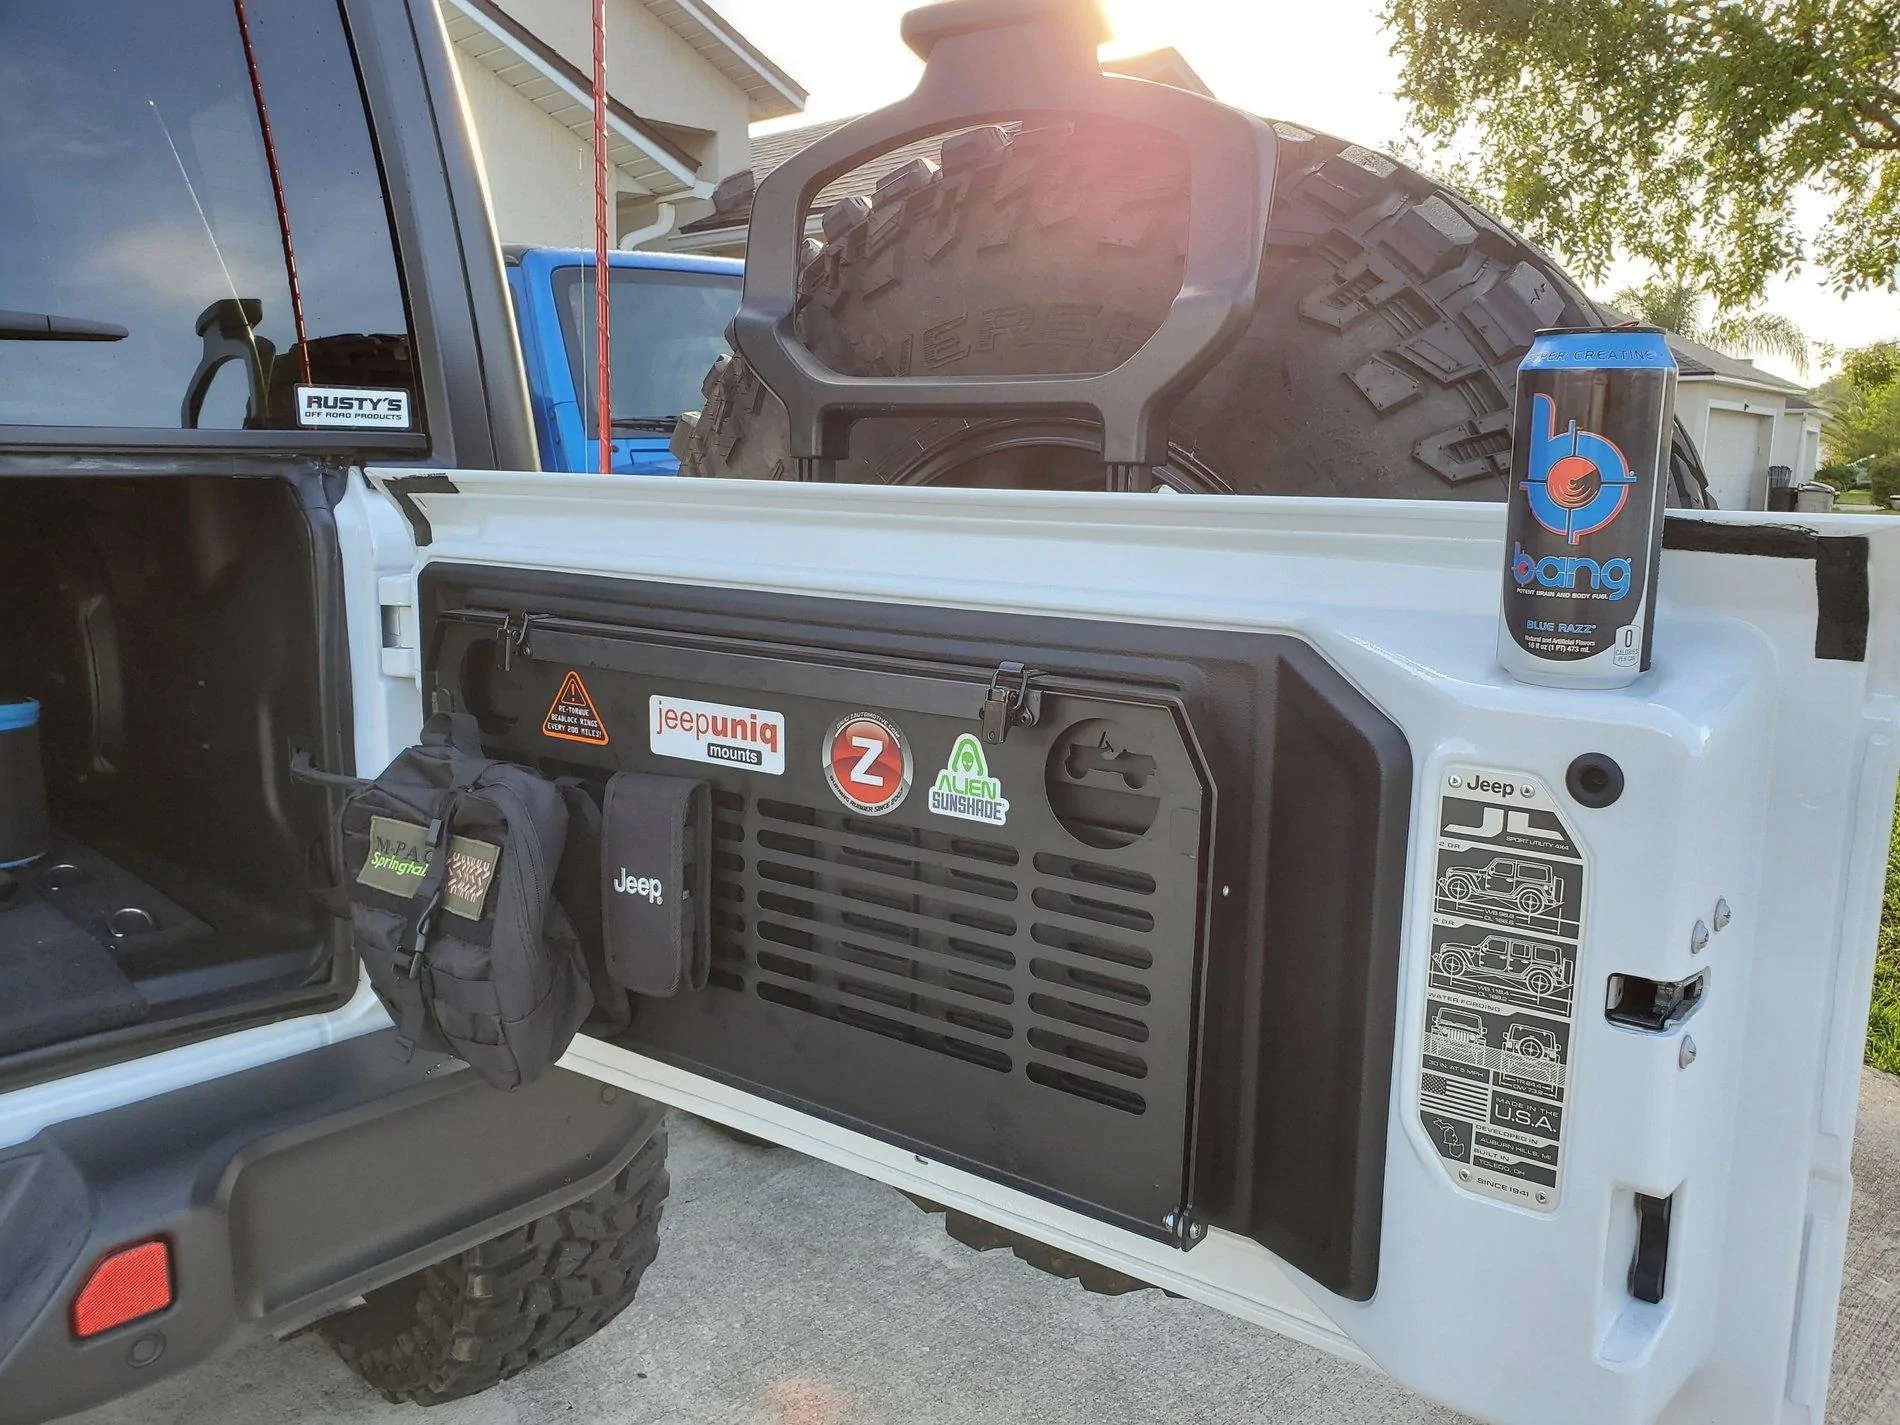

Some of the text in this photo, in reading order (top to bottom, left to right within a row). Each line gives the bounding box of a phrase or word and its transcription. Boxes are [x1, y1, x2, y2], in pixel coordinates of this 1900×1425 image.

[1573, 349, 1655, 361] CREATINE
[307, 395, 402, 411] RUSTY'S
[325, 411, 352, 419] ROAD
[354, 412, 402, 421] PRODUCTS
[1511, 541, 1631, 601] bang
[1536, 589, 1555, 597] BRAIN
[1526, 619, 1555, 632] BLUE
[1528, 641, 1535, 649] 16
[1566, 645, 1580, 653] 473
[1541, 636, 1552, 644] and
[1552, 637, 1575, 645] Artificial
[1624, 629, 1633, 648] 0
[558, 704, 590, 717] RE-TORQUE
[547, 722, 566, 732] EVERY
[567, 725, 579, 734] 200
[551, 713, 598, 728] BEADLOCK RINGS
[656, 700, 778, 754] jeepuniq
[709, 744, 759, 764] mounts
[850, 735, 885, 788] Z
[938, 774, 997, 801] ALIEN
[1467, 775, 1515, 797] Jeep
[932, 790, 1002, 821] SUNSHADE
[1443, 806, 1565, 841] JL
[613, 866, 662, 903] Jeep
[1441, 918, 1455, 926] DR
[1427, 991, 1501, 1013] WATER FORDING
[1449, 1064, 1460, 1072] AT
[1466, 1068, 1484, 1078] MPH
[1495, 1097, 1524, 1109] MADE
[1539, 1107, 1560, 1118] THE
[1494, 1103, 1557, 1133] U.S.A.
[1475, 1124, 1527, 1142] DEVELOPED
[1473, 1147, 1498, 1158] BUILT
[1479, 1137, 1515, 1151] AUBURN
[1513, 1168, 1526, 1176] OH
[1477, 1177, 1530, 1197] SINCE 1941
